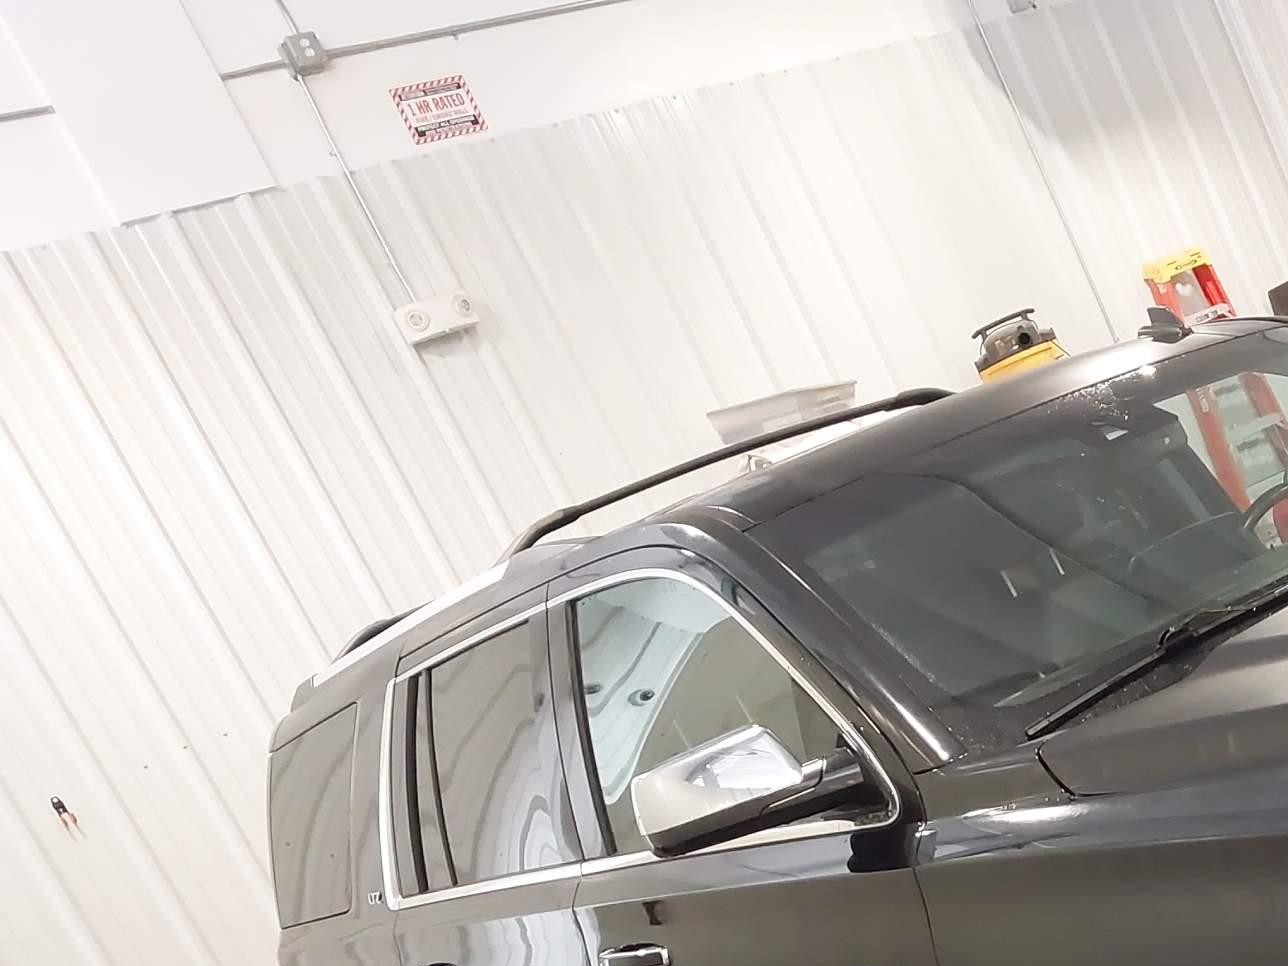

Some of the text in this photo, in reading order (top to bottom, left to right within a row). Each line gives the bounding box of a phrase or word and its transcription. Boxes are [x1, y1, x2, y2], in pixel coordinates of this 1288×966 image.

[407, 103, 417, 116] 1
[417, 98, 431, 114] HR
[431, 93, 466, 112] RATED
